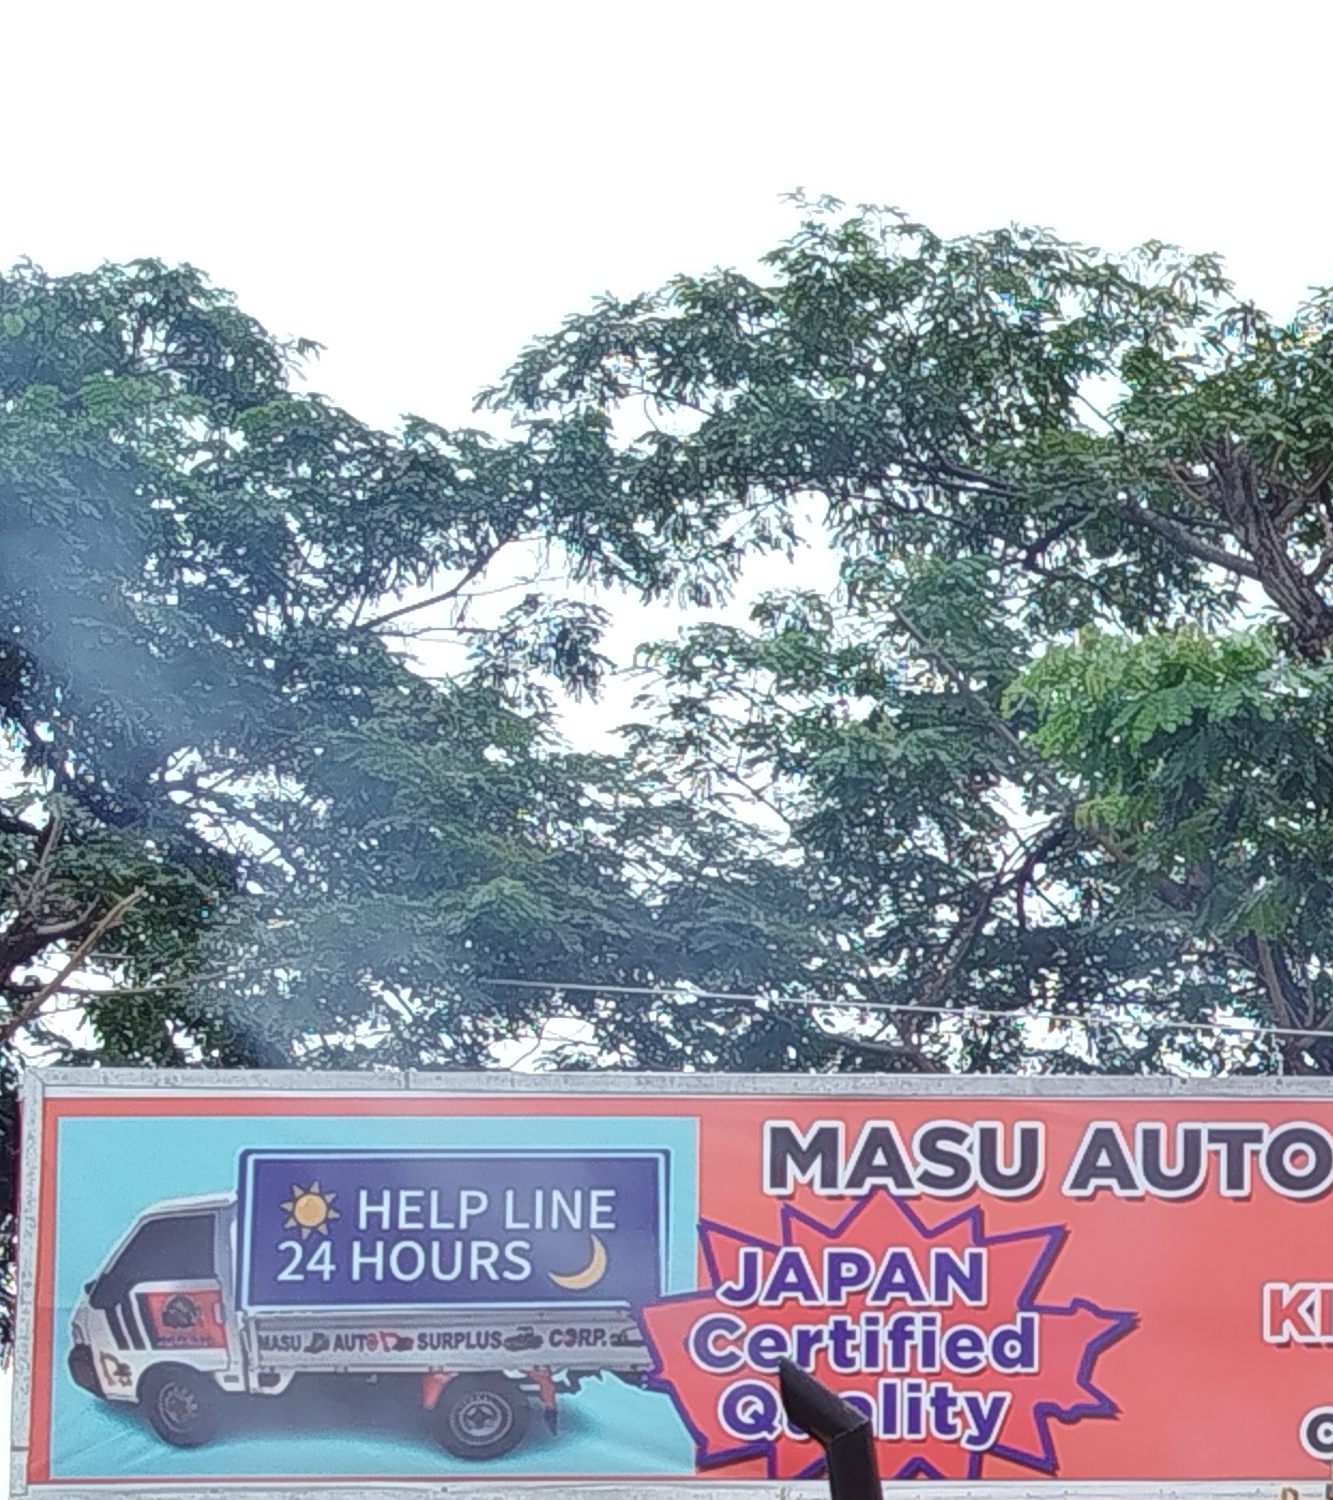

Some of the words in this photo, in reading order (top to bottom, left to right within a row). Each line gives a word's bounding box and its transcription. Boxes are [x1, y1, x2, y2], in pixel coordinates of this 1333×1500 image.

[768, 1124, 1040, 1191] MASU
[358, 1189, 489, 1230] HELP
[505, 1189, 616, 1230] LINE
[277, 1240, 336, 1281] 24
[351, 1240, 532, 1281] HOURS
[718, 1250, 985, 1302] JAPAN
[258, 1334, 301, 1351] MASU
[333, 1334, 378, 1352] AUTO
[416, 1331, 503, 1350] SURPLUS
[548, 1328, 608, 1349] CORP.
[695, 1314, 1036, 1371] Certified
[721, 1380, 1008, 1446] Qlity
